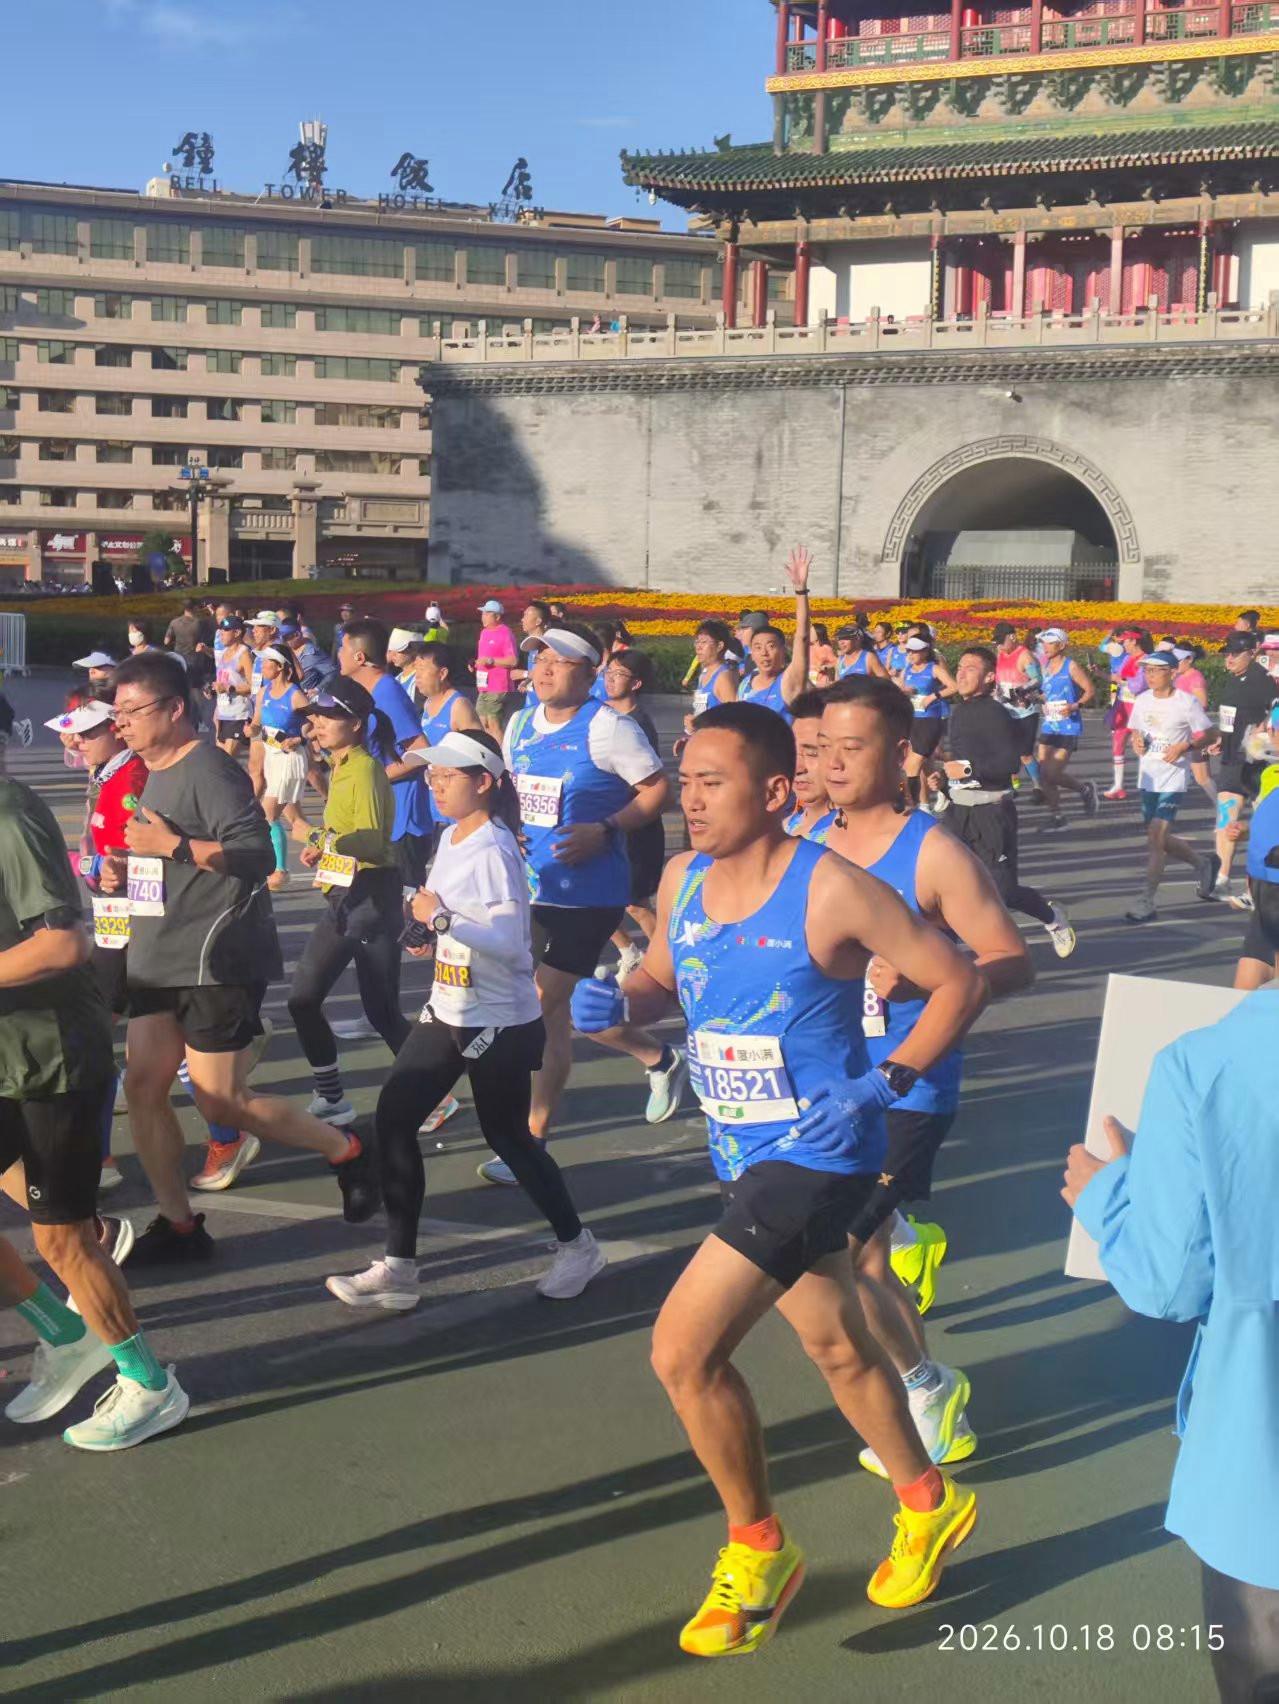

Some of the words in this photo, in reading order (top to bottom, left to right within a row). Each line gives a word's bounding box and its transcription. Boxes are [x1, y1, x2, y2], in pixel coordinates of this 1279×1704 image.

[170, 175, 222, 193] BELL
[264, 183, 347, 203] TOWER
[378, 192, 446, 213] HOTEL
[519, 793, 557, 815] 56356
[703, 1067, 782, 1101] 18521
